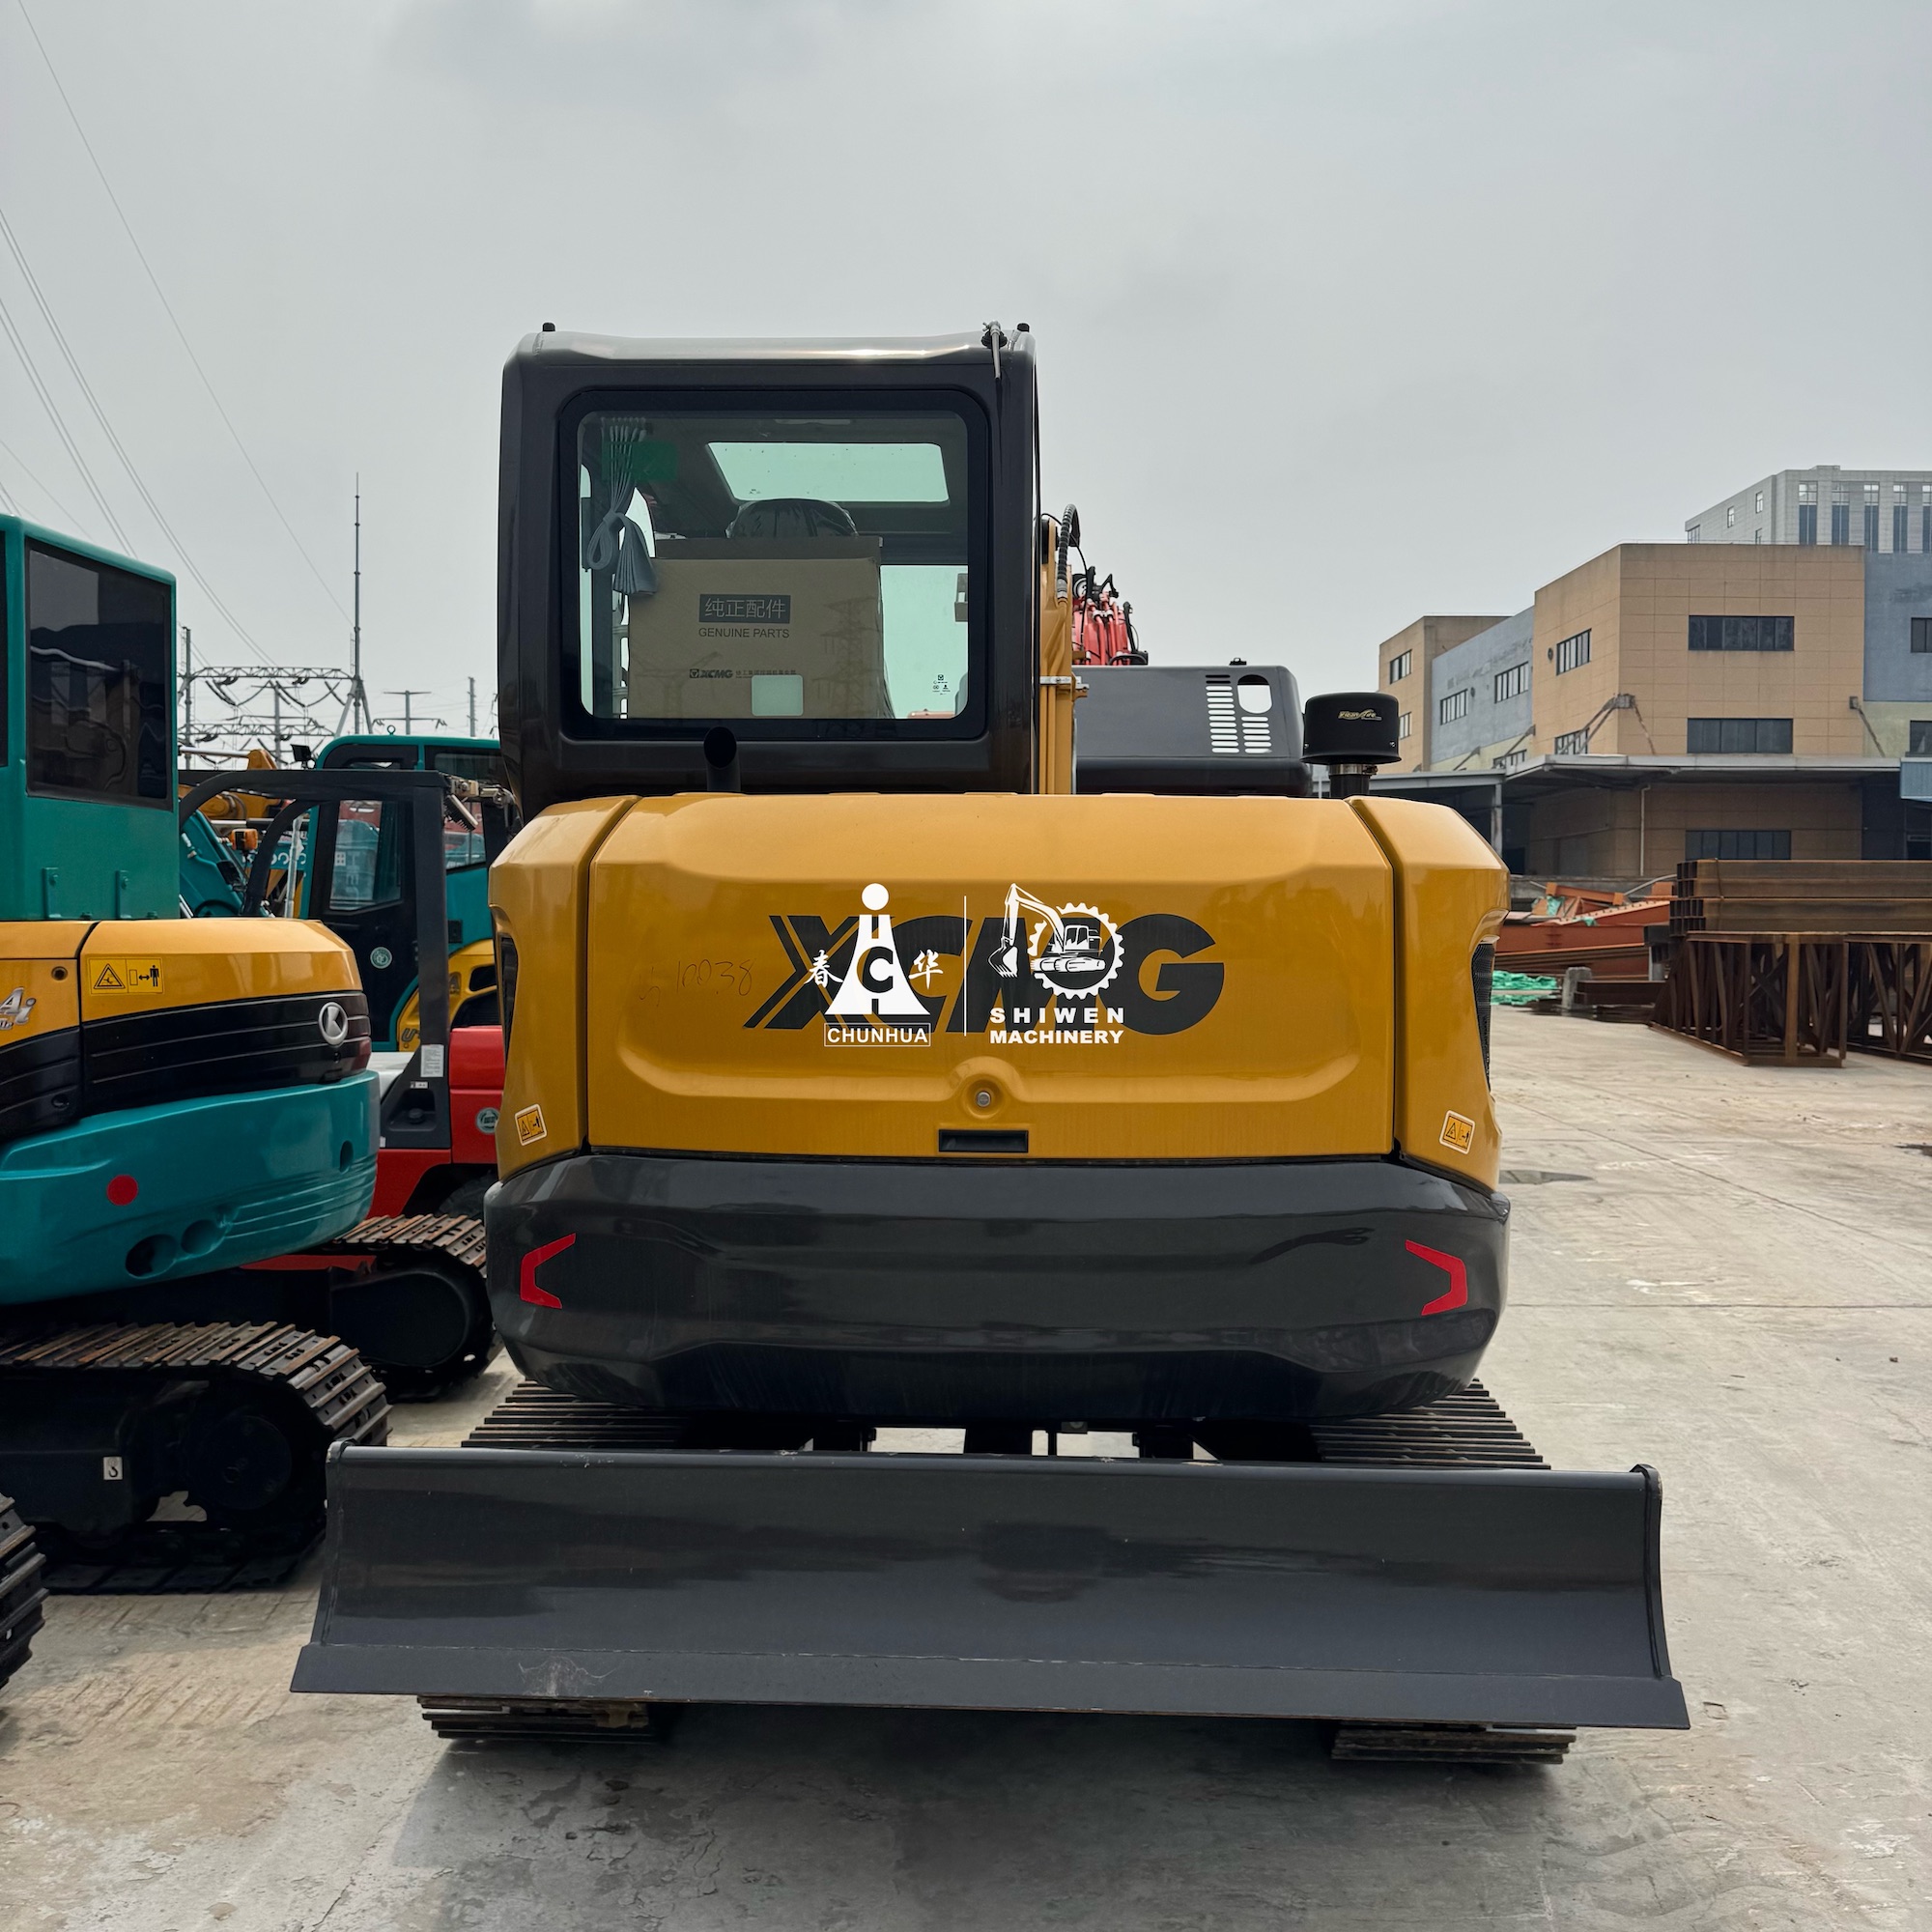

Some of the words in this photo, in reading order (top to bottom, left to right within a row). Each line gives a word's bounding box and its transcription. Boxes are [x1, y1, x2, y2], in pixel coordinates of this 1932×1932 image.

[704, 597, 786, 619] 纯正配件
[698, 628, 751, 638] GENUINE
[753, 628, 790, 639] PARTS
[700, 668, 733, 679] XCMG
[743, 914, 1225, 1035] XCMG
